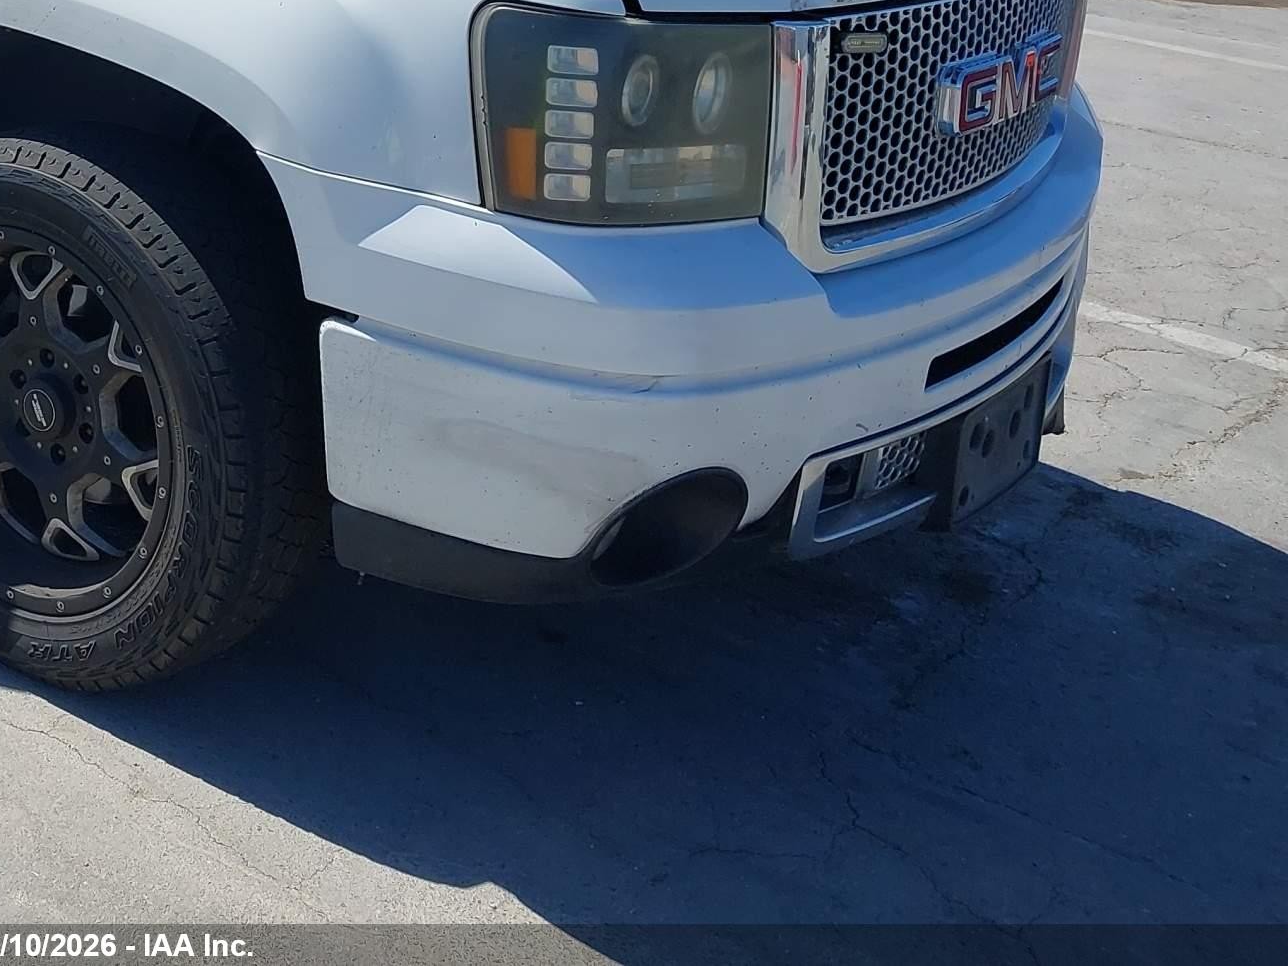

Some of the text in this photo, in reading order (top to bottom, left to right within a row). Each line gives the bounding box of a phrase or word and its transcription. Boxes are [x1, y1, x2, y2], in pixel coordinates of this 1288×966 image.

[952, 36, 1061, 135] GMC
[113, 444, 203, 650] SCORPION
[27, 639, 97, 662] ATR
